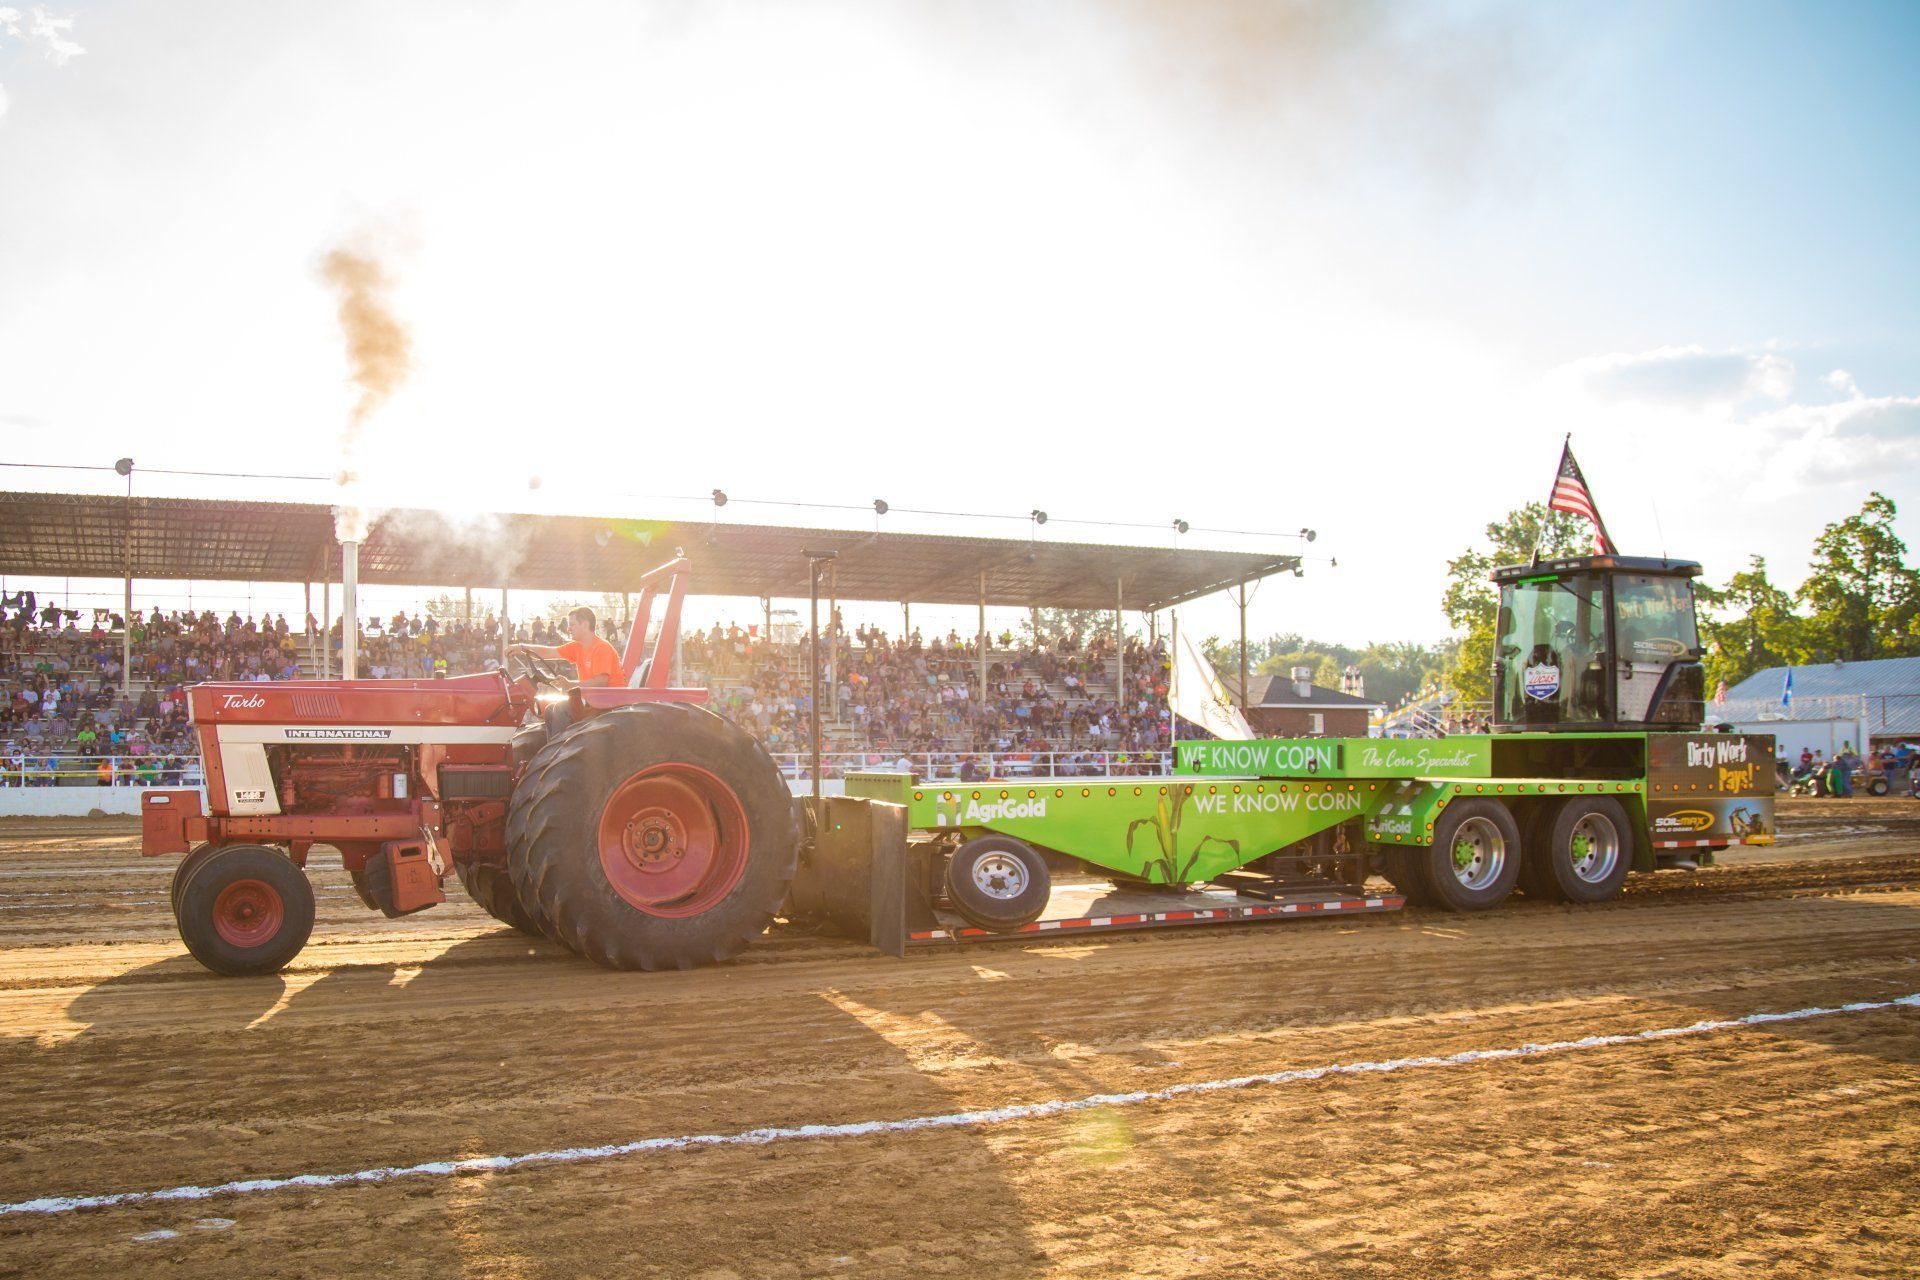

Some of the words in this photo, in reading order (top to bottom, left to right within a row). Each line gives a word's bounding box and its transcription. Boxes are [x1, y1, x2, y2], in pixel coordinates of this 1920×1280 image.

[1528, 674, 1556, 684] LUCAS
[222, 693, 265, 709] Turbo
[288, 730, 388, 739] INTERNATIONAL
[1181, 746, 1206, 768] WE
[1212, 746, 1275, 769] KNOW
[1362, 748, 1383, 767] The
[1386, 749, 1414, 768] Corn
[1416, 748, 1478, 774] Specialist
[1687, 741, 1715, 768] Dirty
[1717, 737, 1747, 764] Work
[1718, 762, 1753, 794] Pays!
[965, 798, 1046, 823] AgriGold
[1194, 794, 1226, 814] WE
[1233, 793, 1300, 813] KNOW
[1305, 792, 1361, 812] CORN
[1655, 817, 1705, 826] SOIL-MAX
